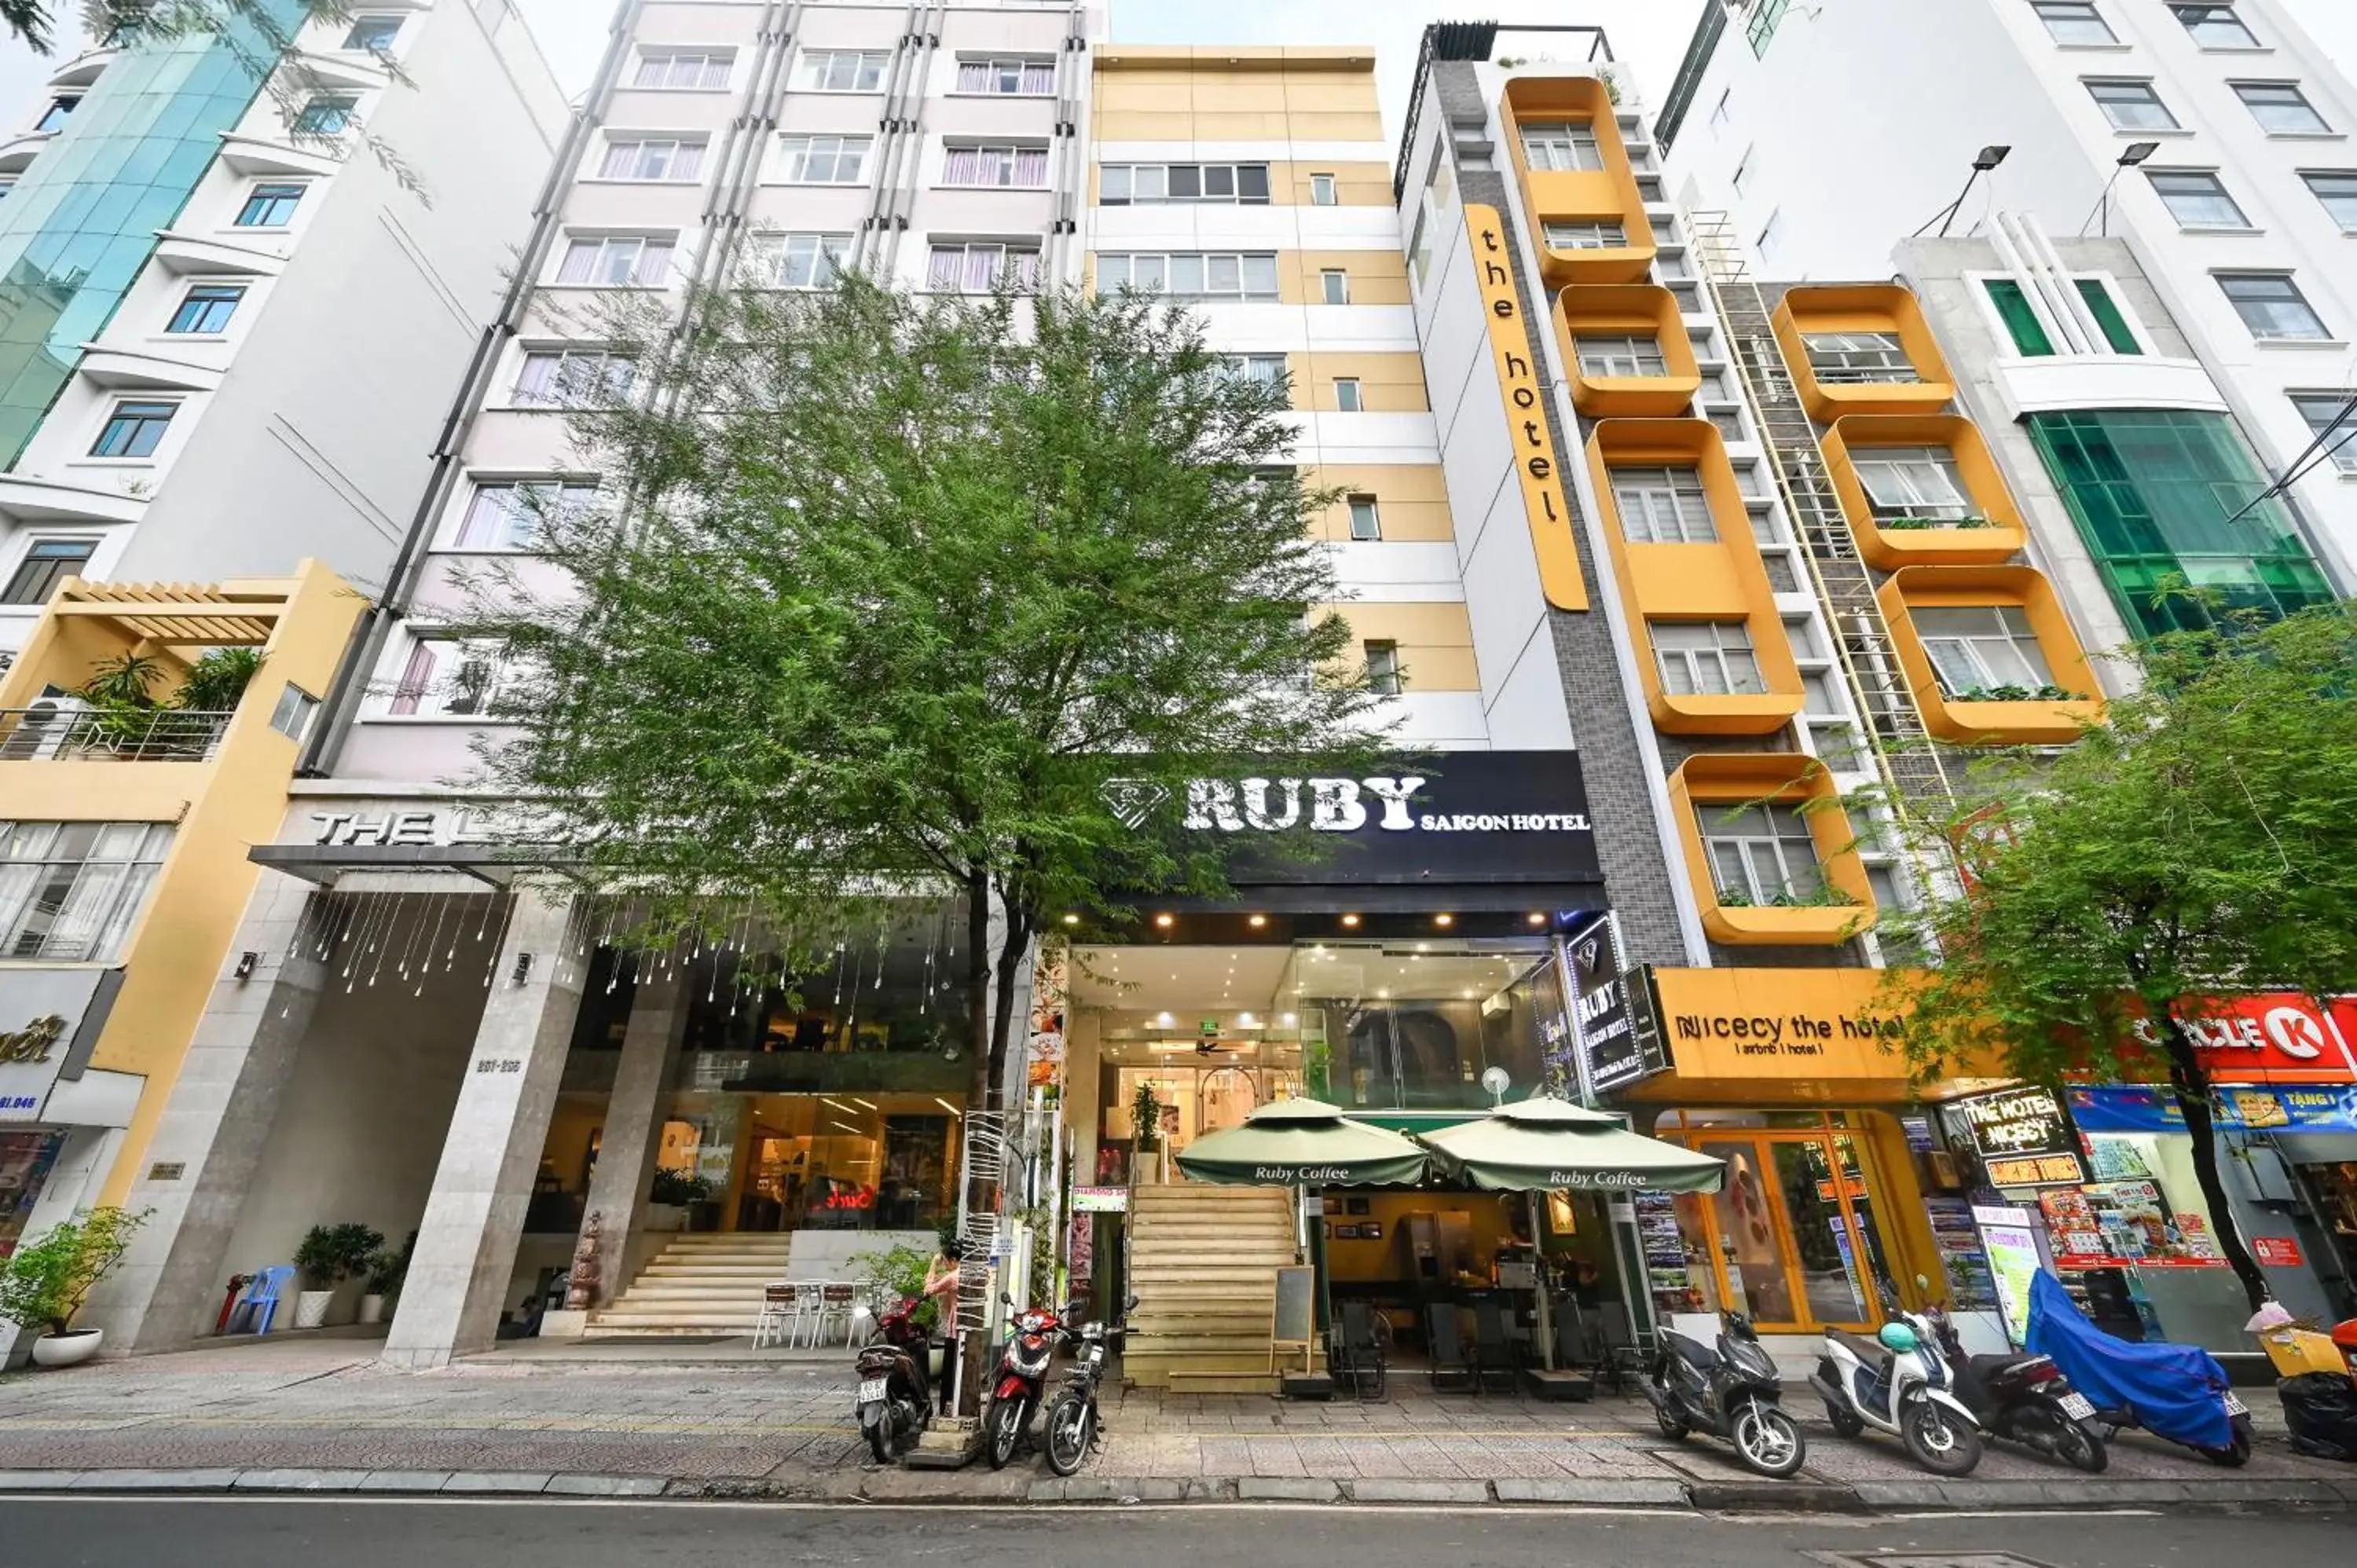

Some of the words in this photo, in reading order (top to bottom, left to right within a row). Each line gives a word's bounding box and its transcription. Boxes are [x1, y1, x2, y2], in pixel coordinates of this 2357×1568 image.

[1481, 229, 1513, 317] the
[1505, 350, 1557, 522] hotel
[1183, 777, 1427, 832] RUBY
[312, 811, 435, 845] THE
[1420, 814, 1509, 831] SAIGON
[1511, 814, 1591, 831] HOTEL
[1578, 980, 1616, 1024] RUBY
[1791, 1014, 1832, 1039] the
[1965, 1101, 2002, 1123] THE
[1255, 1166, 1295, 1181] Ruby
[1299, 1166, 1350, 1179] Coffee
[1549, 1170, 1591, 1188] Ruby
[1594, 1170, 1647, 1185] Coffee
